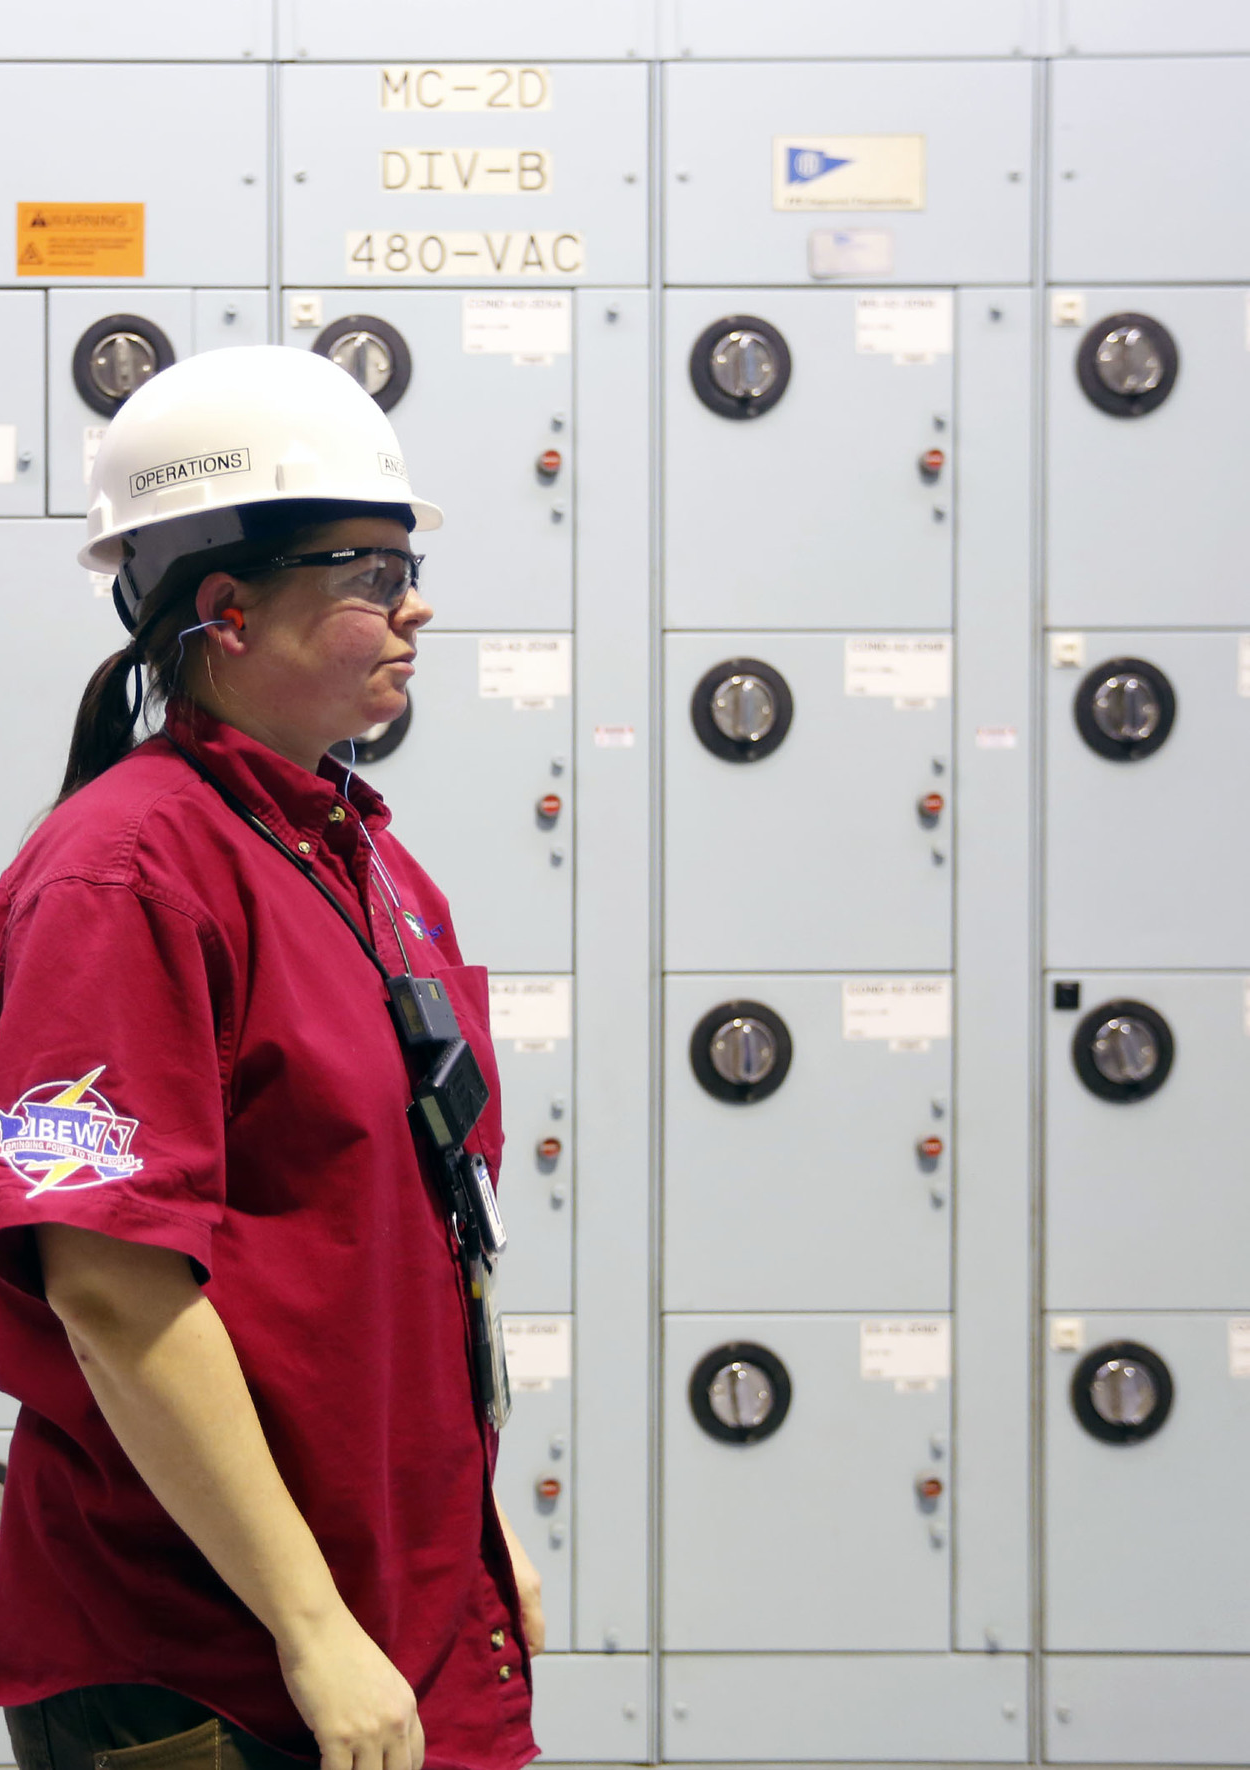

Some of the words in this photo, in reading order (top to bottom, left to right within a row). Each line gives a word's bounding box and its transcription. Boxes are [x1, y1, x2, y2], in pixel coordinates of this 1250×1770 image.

[381, 69, 547, 108] MC-2D
[382, 151, 547, 191] DIV-B
[351, 234, 580, 273] 480-VAC
[135, 453, 243, 492] OPERATIONS
[5, 1140, 44, 1151] BRINGING
[46, 1142, 74, 1156] POWER
[75, 1149, 86, 1160] TO
[87, 1153, 102, 1164] THE
[102, 1156, 132, 1166] PEOPLE
[29, 1117, 99, 1147] IBEW
[91, 1112, 139, 1157] 77
